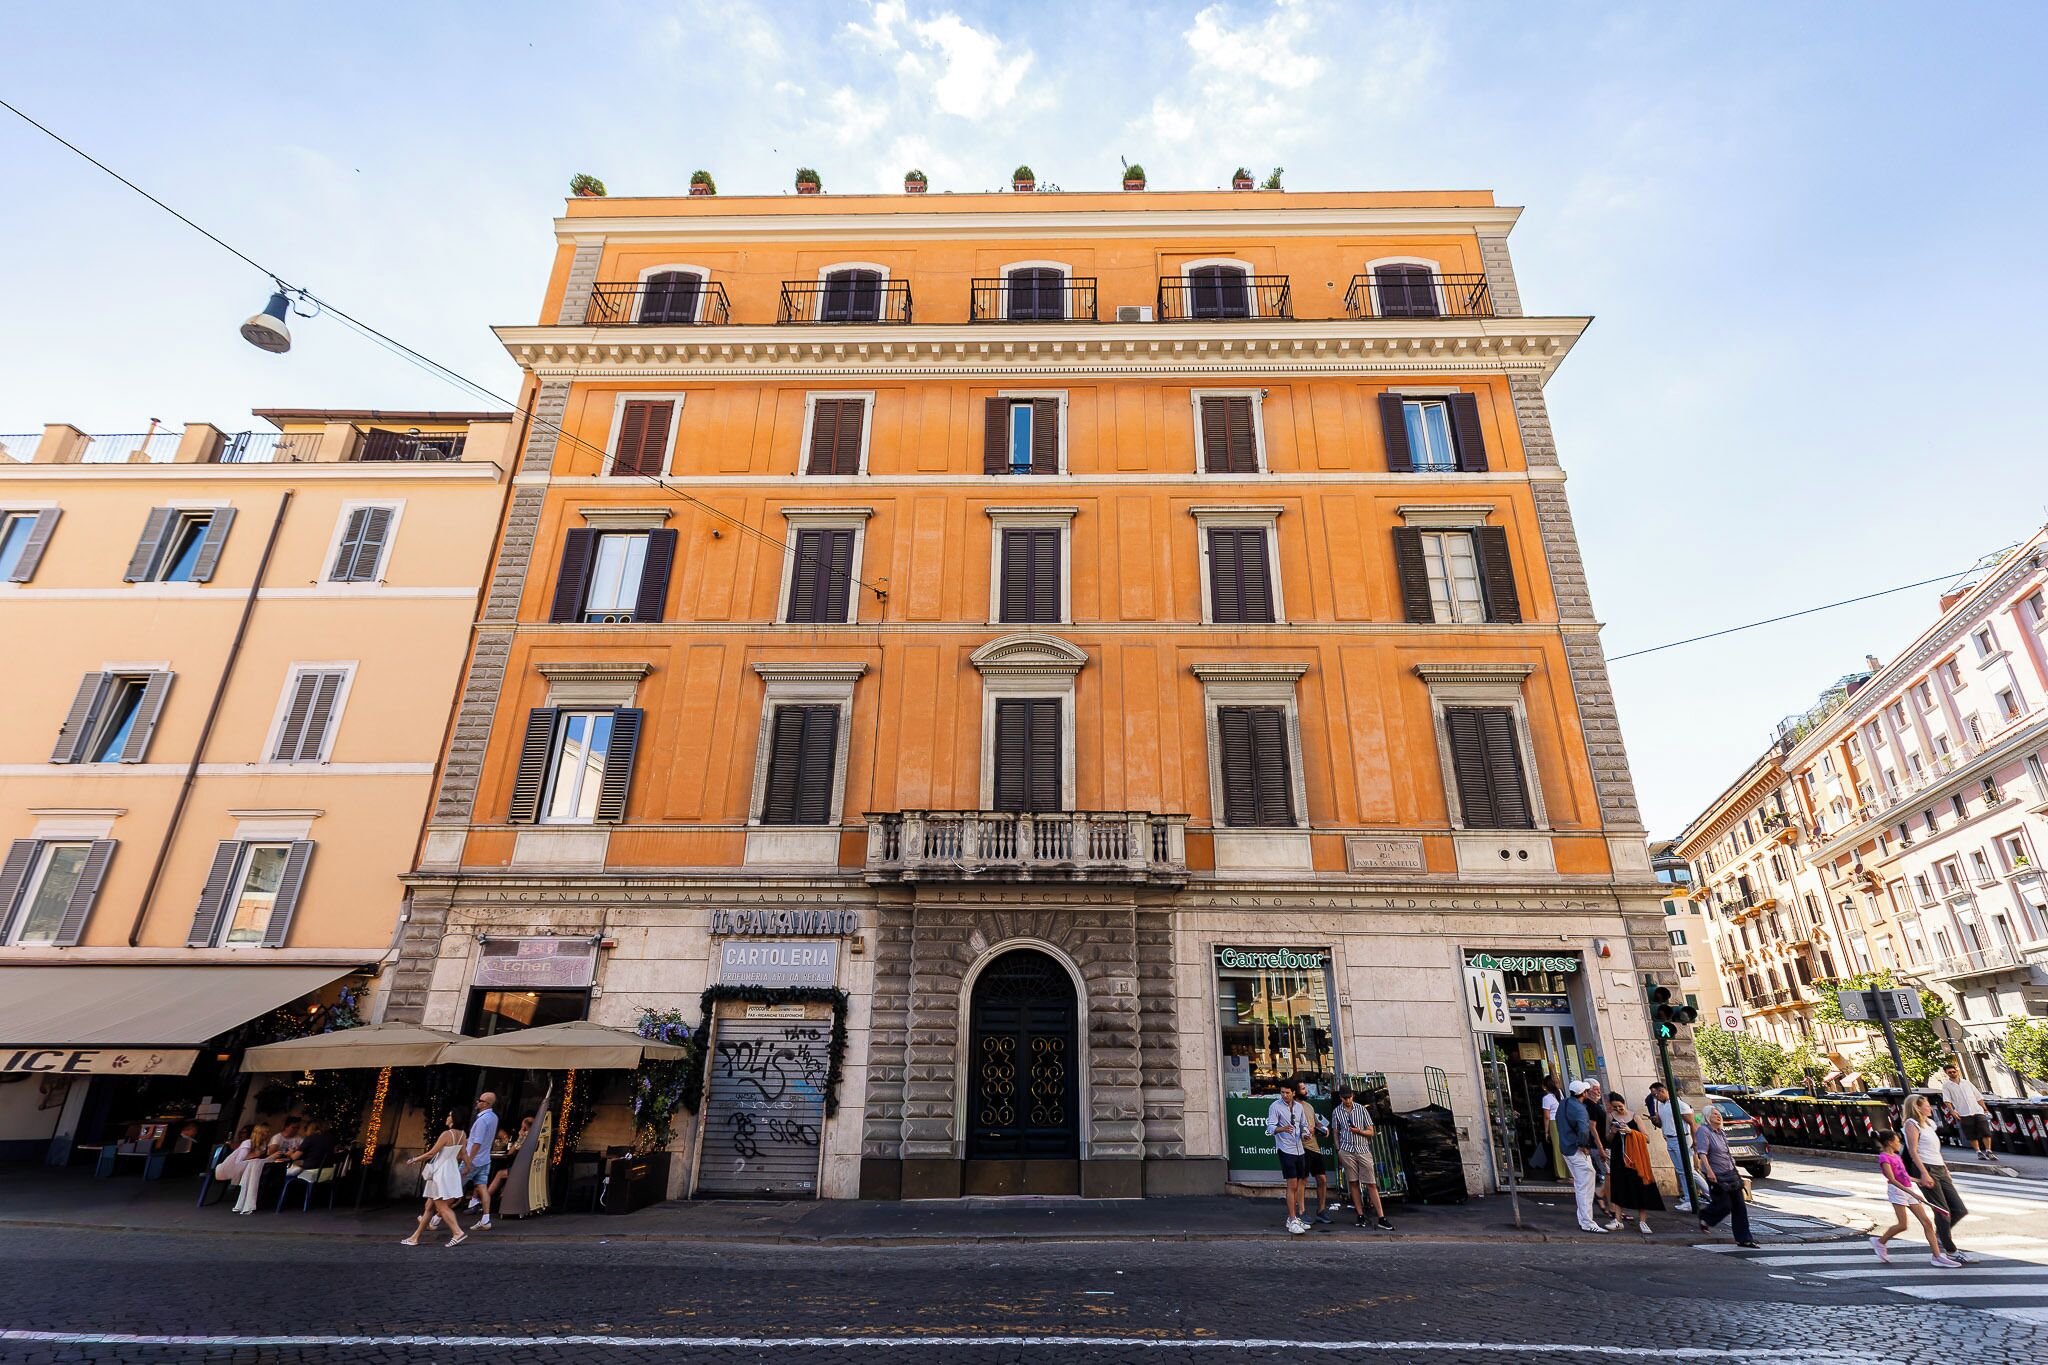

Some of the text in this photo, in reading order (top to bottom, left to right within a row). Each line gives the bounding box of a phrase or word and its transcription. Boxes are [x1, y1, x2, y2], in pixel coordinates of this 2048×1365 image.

[1376, 843, 1394, 851] VIA
[485, 892, 601, 902] INGENIO
[624, 892, 713, 902] NATAM
[736, 893, 844, 903] LABORE
[937, 892, 1113, 903] PERFECTAM
[709, 909, 858, 936] IL CALAMAIO
[726, 947, 830, 966] CARTOLERIA
[1221, 947, 1324, 968] Carrefour
[1500, 955, 1578, 976] express
[722, 972, 768, 981] PROFUMERIA
[803, 973, 831, 982] REGALO
[3, 1050, 100, 1073] ICE
[1239, 1145, 1257, 1154] Tutti
[1320, 1146, 1333, 1155] lio!
